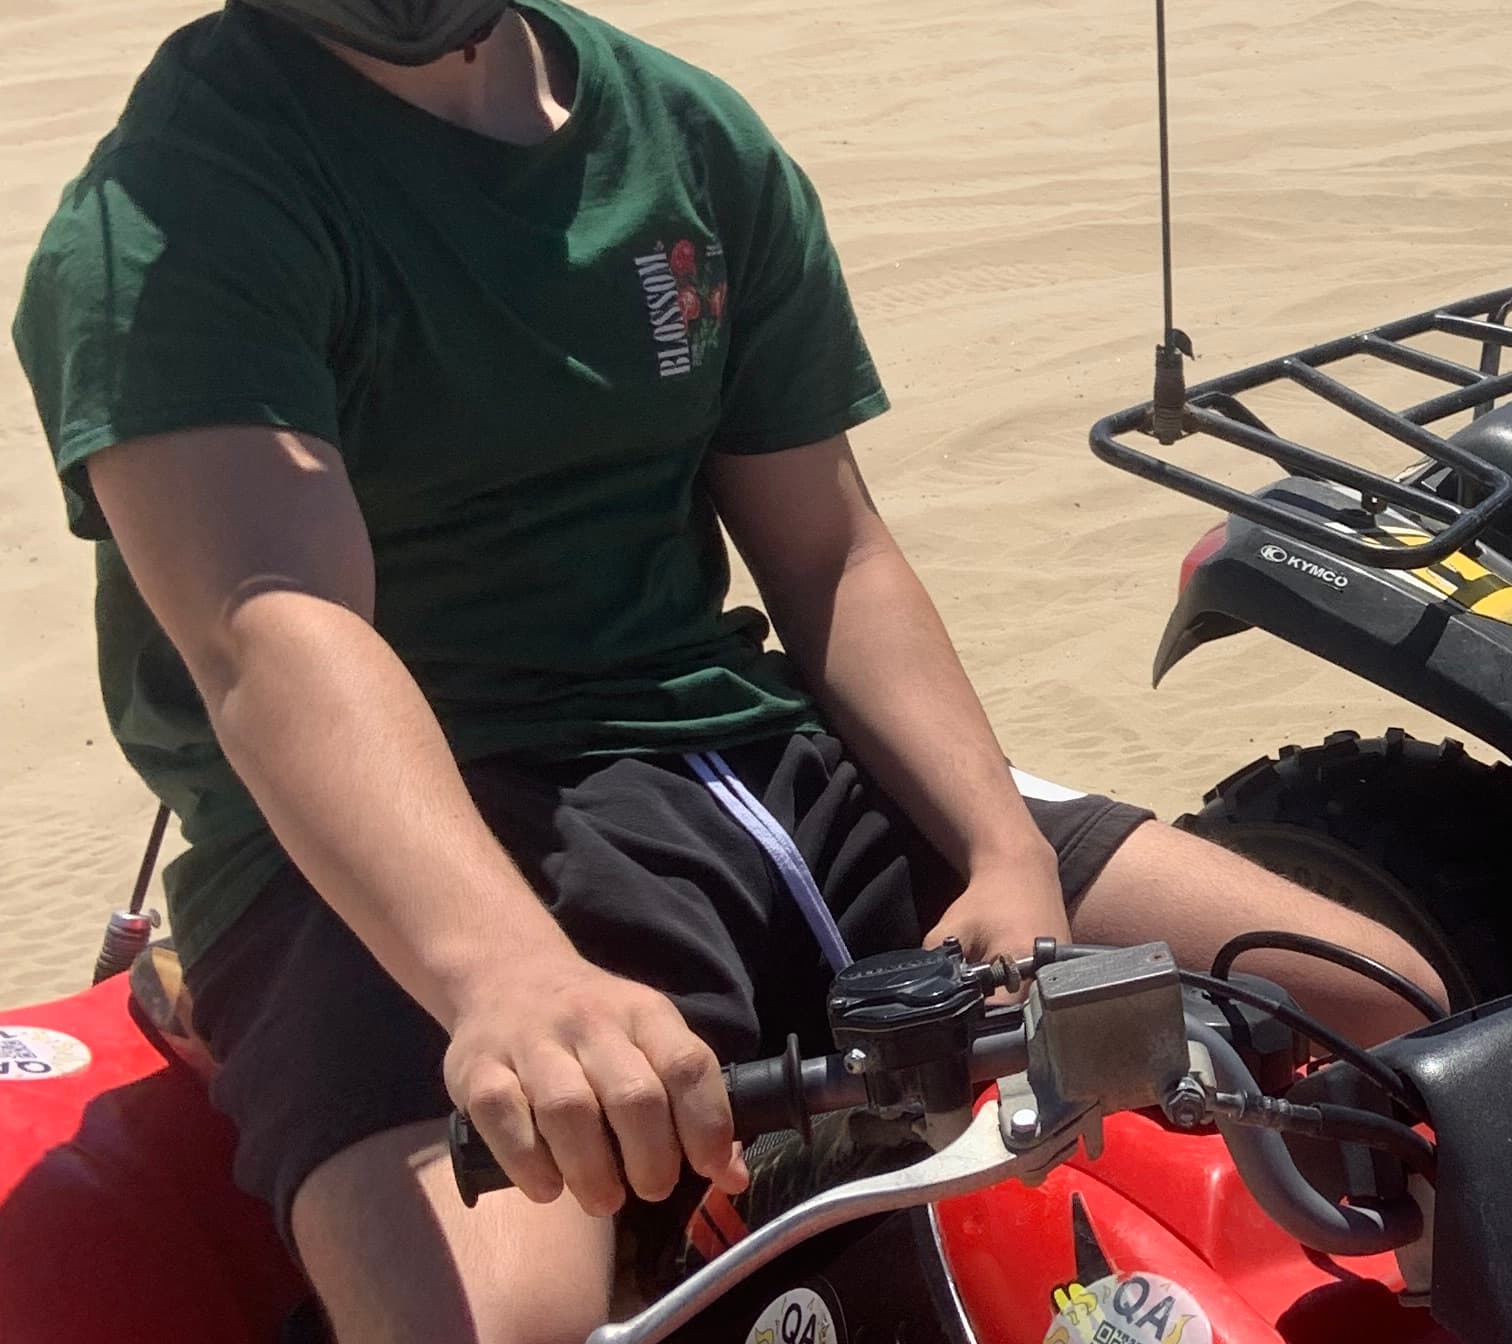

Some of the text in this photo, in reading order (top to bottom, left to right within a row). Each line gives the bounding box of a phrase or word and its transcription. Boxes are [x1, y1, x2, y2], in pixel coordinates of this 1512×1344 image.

[633, 251, 692, 378] BLOSSOM
[1286, 555, 1349, 588] KYMCO
[1112, 1276, 1177, 1342] QA
